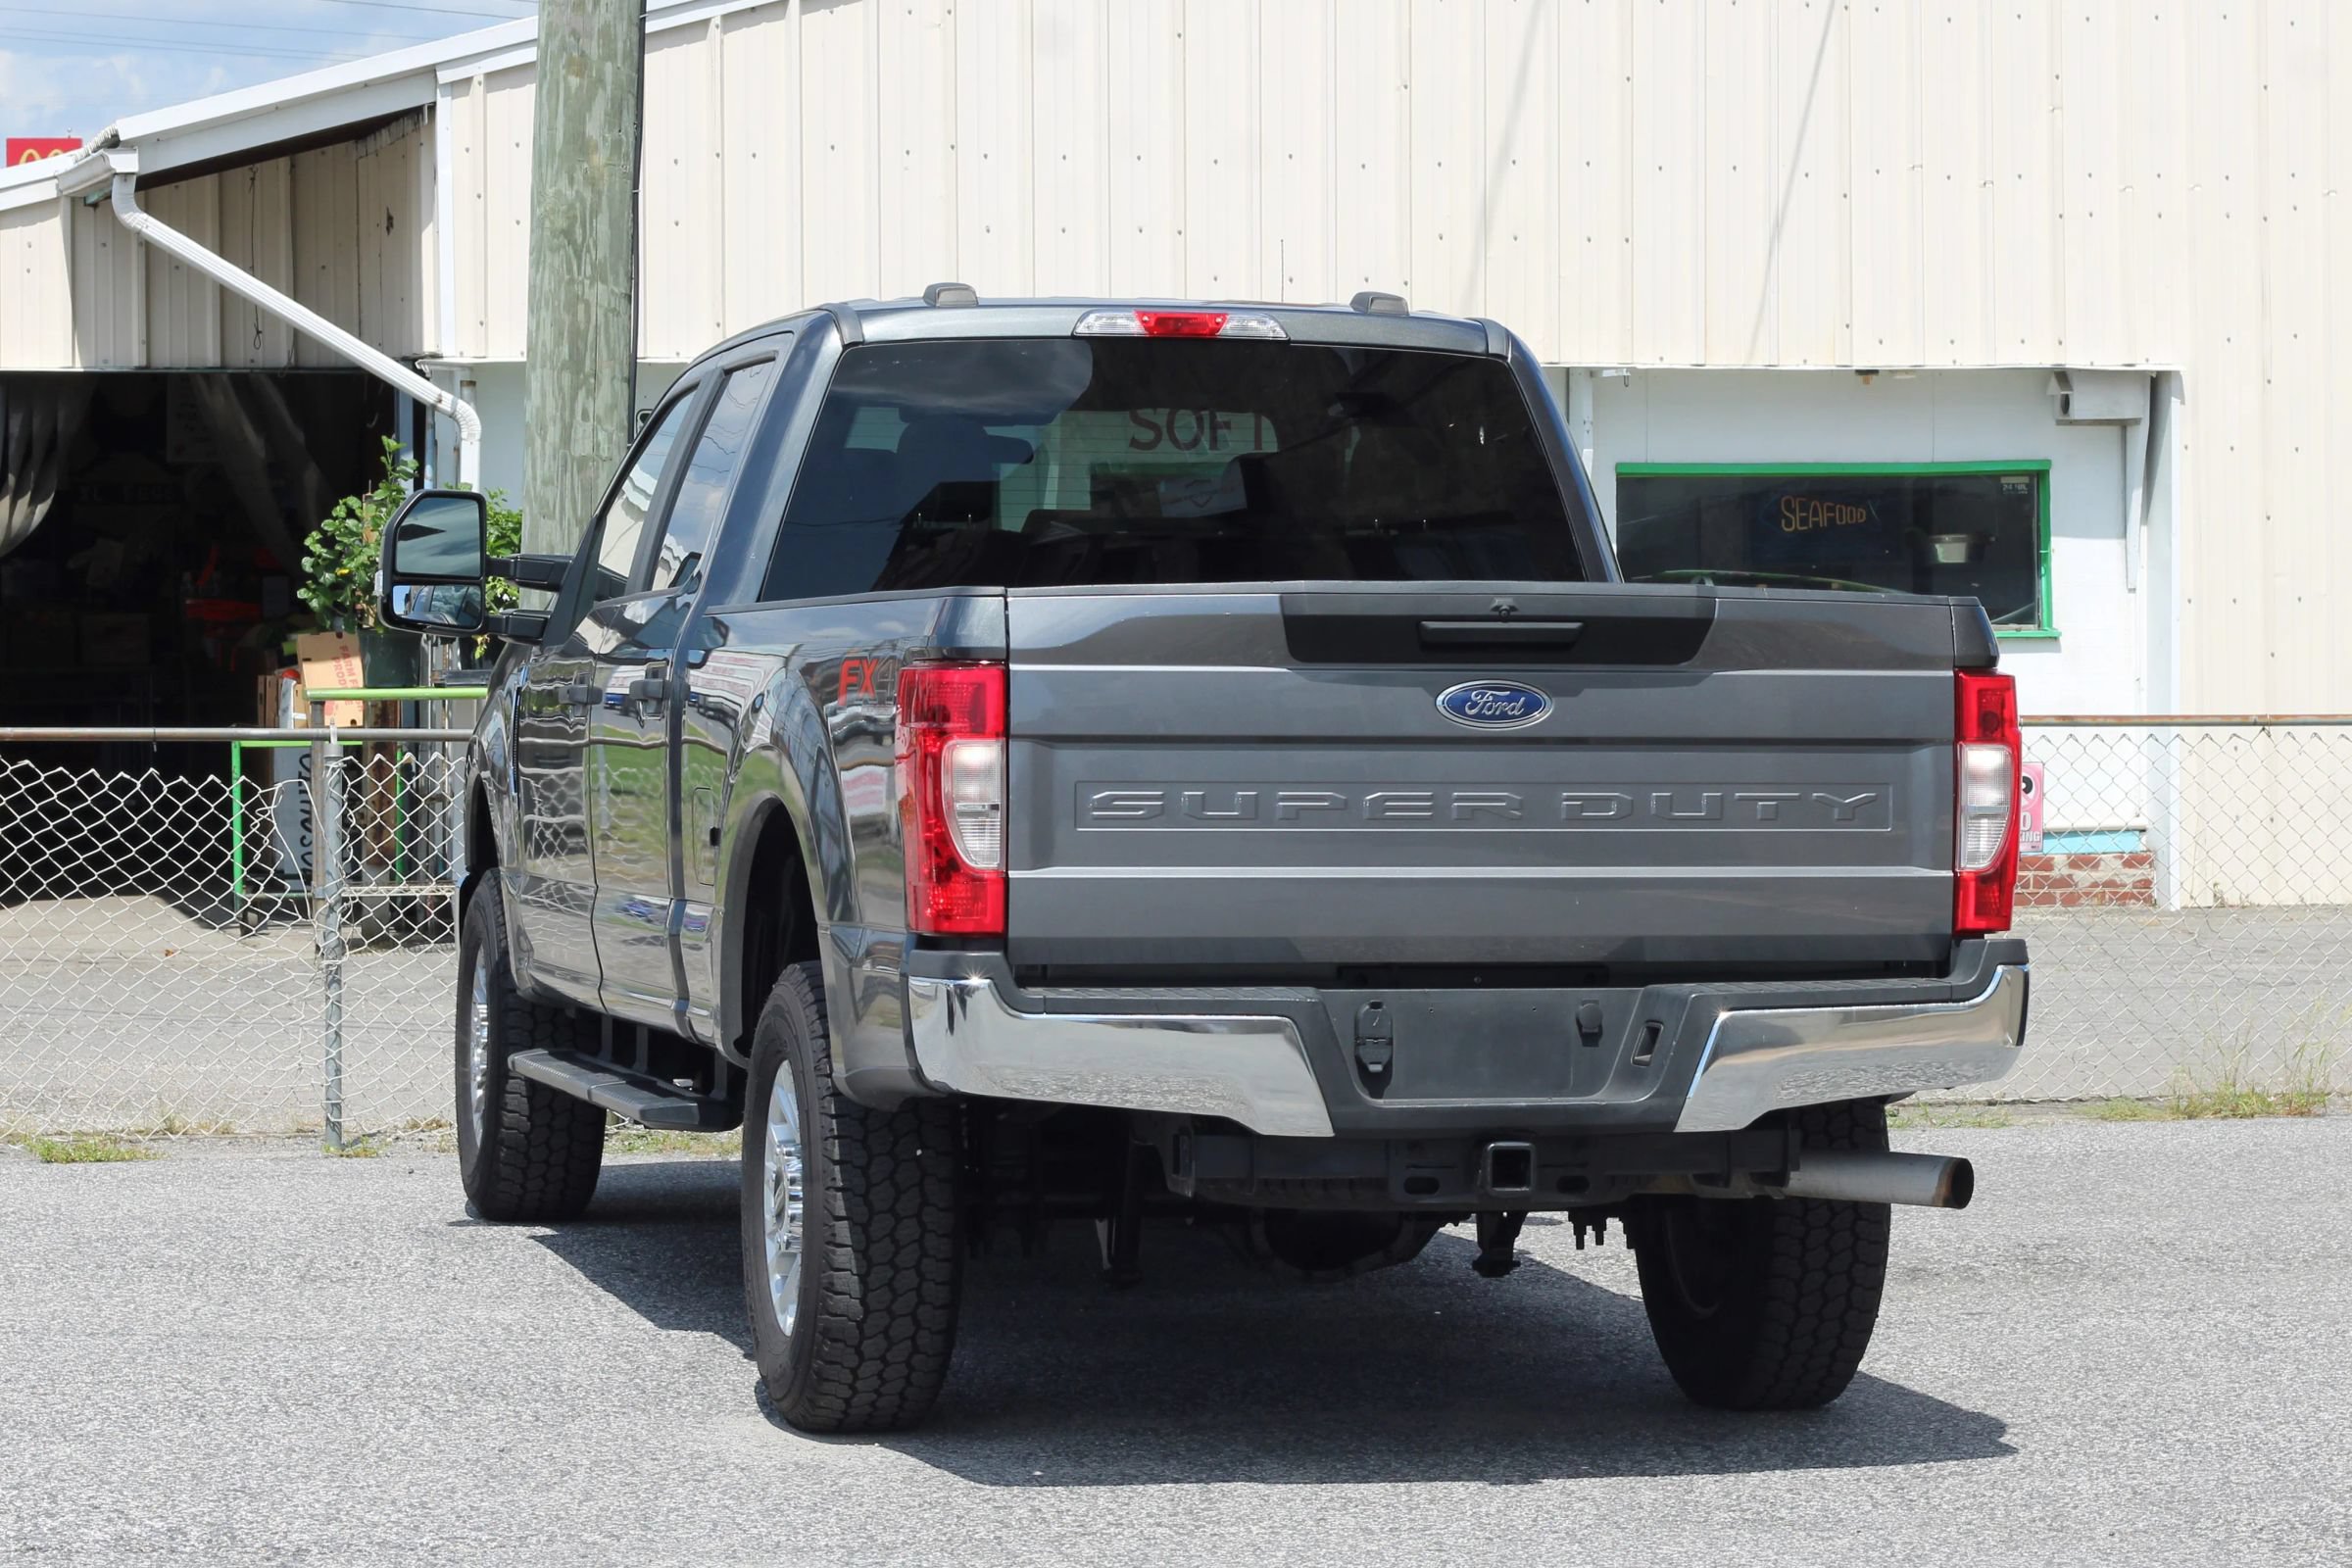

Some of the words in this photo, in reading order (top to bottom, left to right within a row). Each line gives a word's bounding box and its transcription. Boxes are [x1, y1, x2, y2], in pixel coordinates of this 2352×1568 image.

[1781, 495, 1867, 532] SEAFOOD
[838, 657, 897, 707] FX4
[1464, 689, 1526, 715] Ford
[1089, 791, 1523, 820] SUPER
[1560, 792, 1878, 821] DUTY
